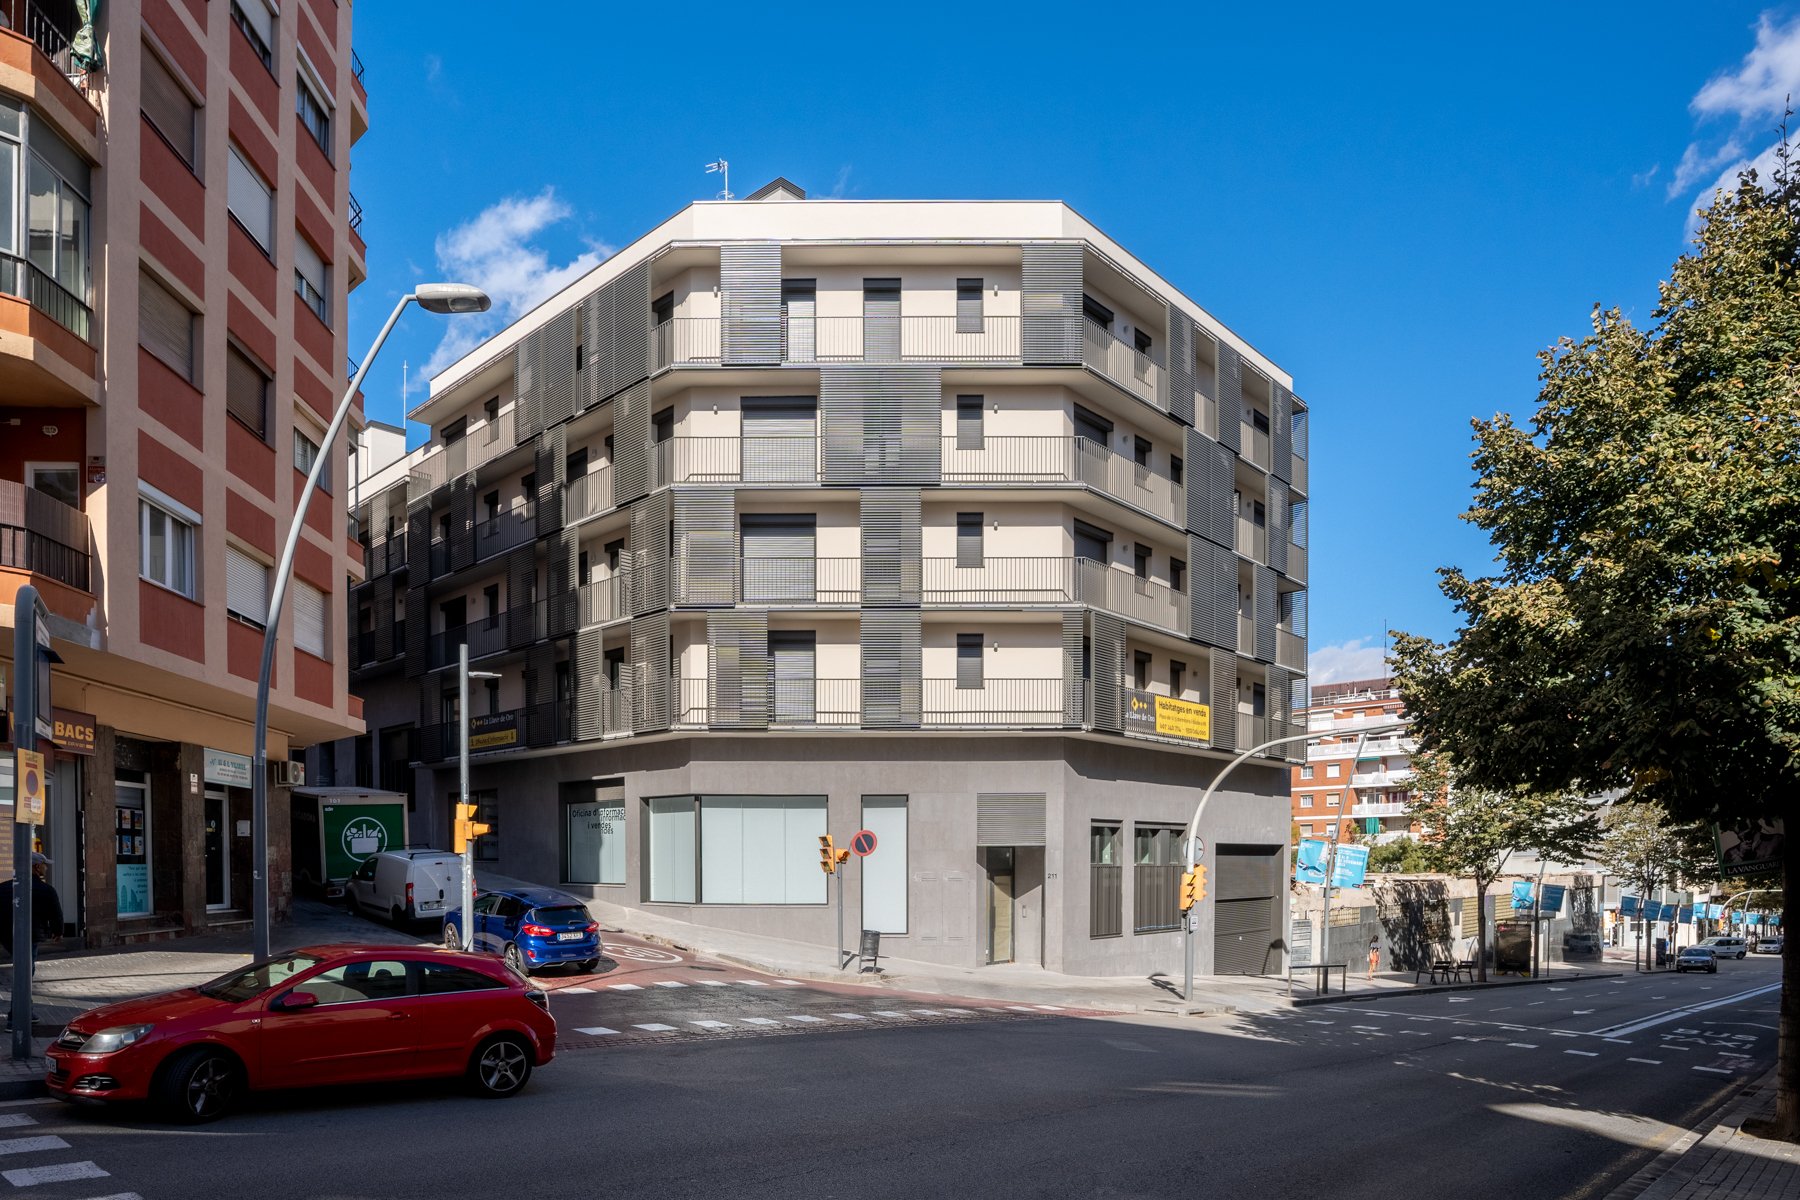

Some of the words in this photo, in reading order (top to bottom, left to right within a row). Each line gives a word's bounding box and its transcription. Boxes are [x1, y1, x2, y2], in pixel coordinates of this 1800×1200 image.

[1158, 701, 1185, 714] Habitatges
[52, 720, 94, 742] BACS
[572, 809, 591, 817] Oficina
[1672, 1028, 1758, 1040] BUS
[1660, 1034, 1754, 1049] TAXI
